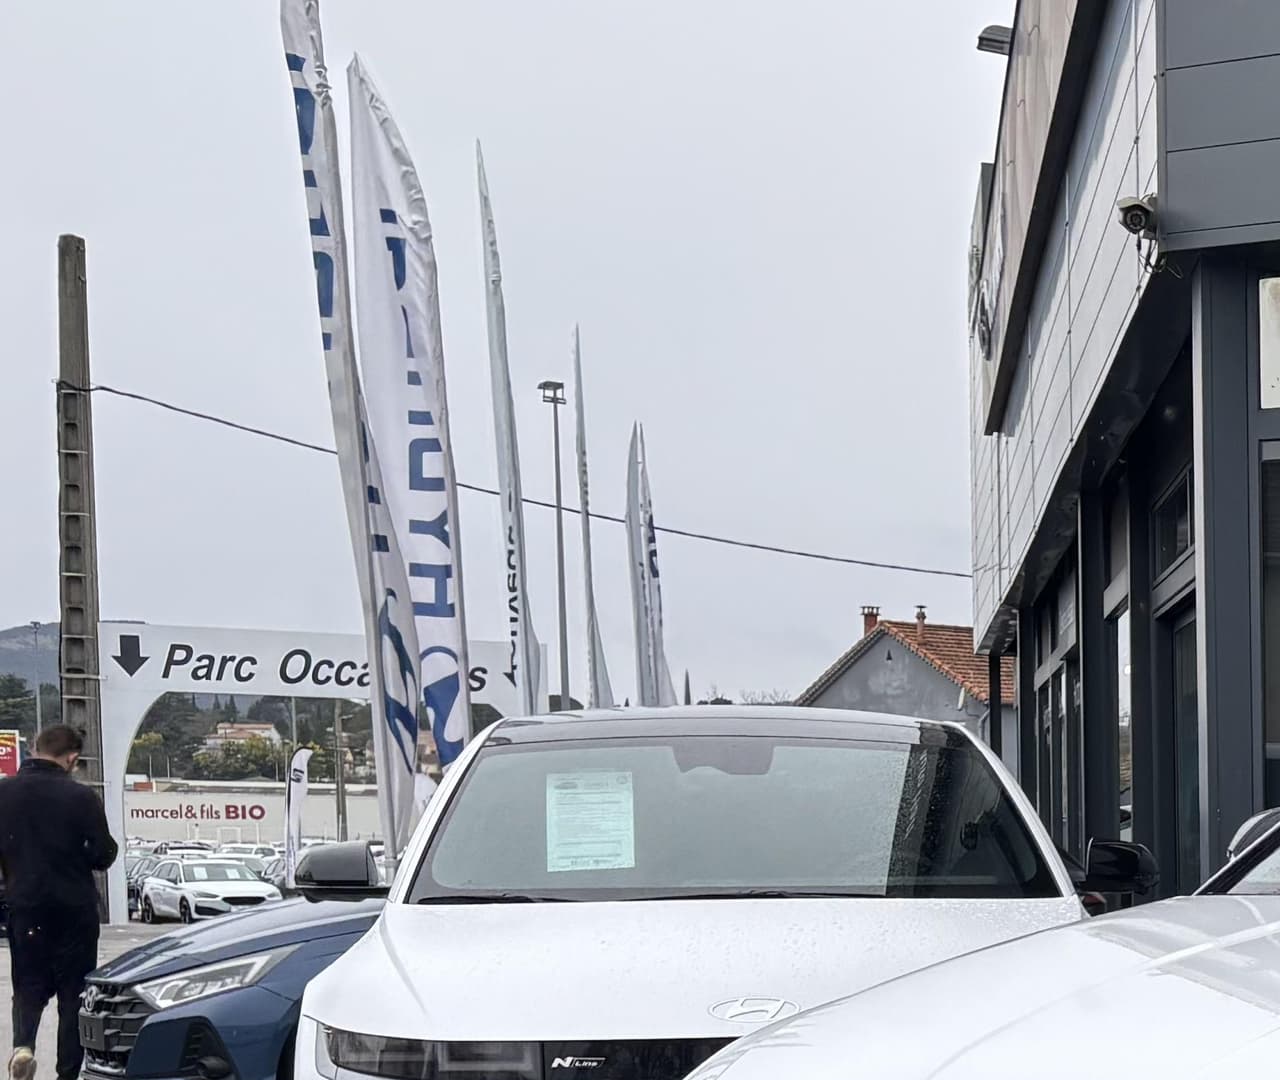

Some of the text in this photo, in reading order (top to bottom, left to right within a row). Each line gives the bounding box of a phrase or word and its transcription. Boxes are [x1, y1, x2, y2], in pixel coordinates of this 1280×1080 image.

[161, 643, 488, 692] Parc Occas
[130, 804, 266, 820] marcel & fils BIO
[551, 1056, 574, 1068] N
